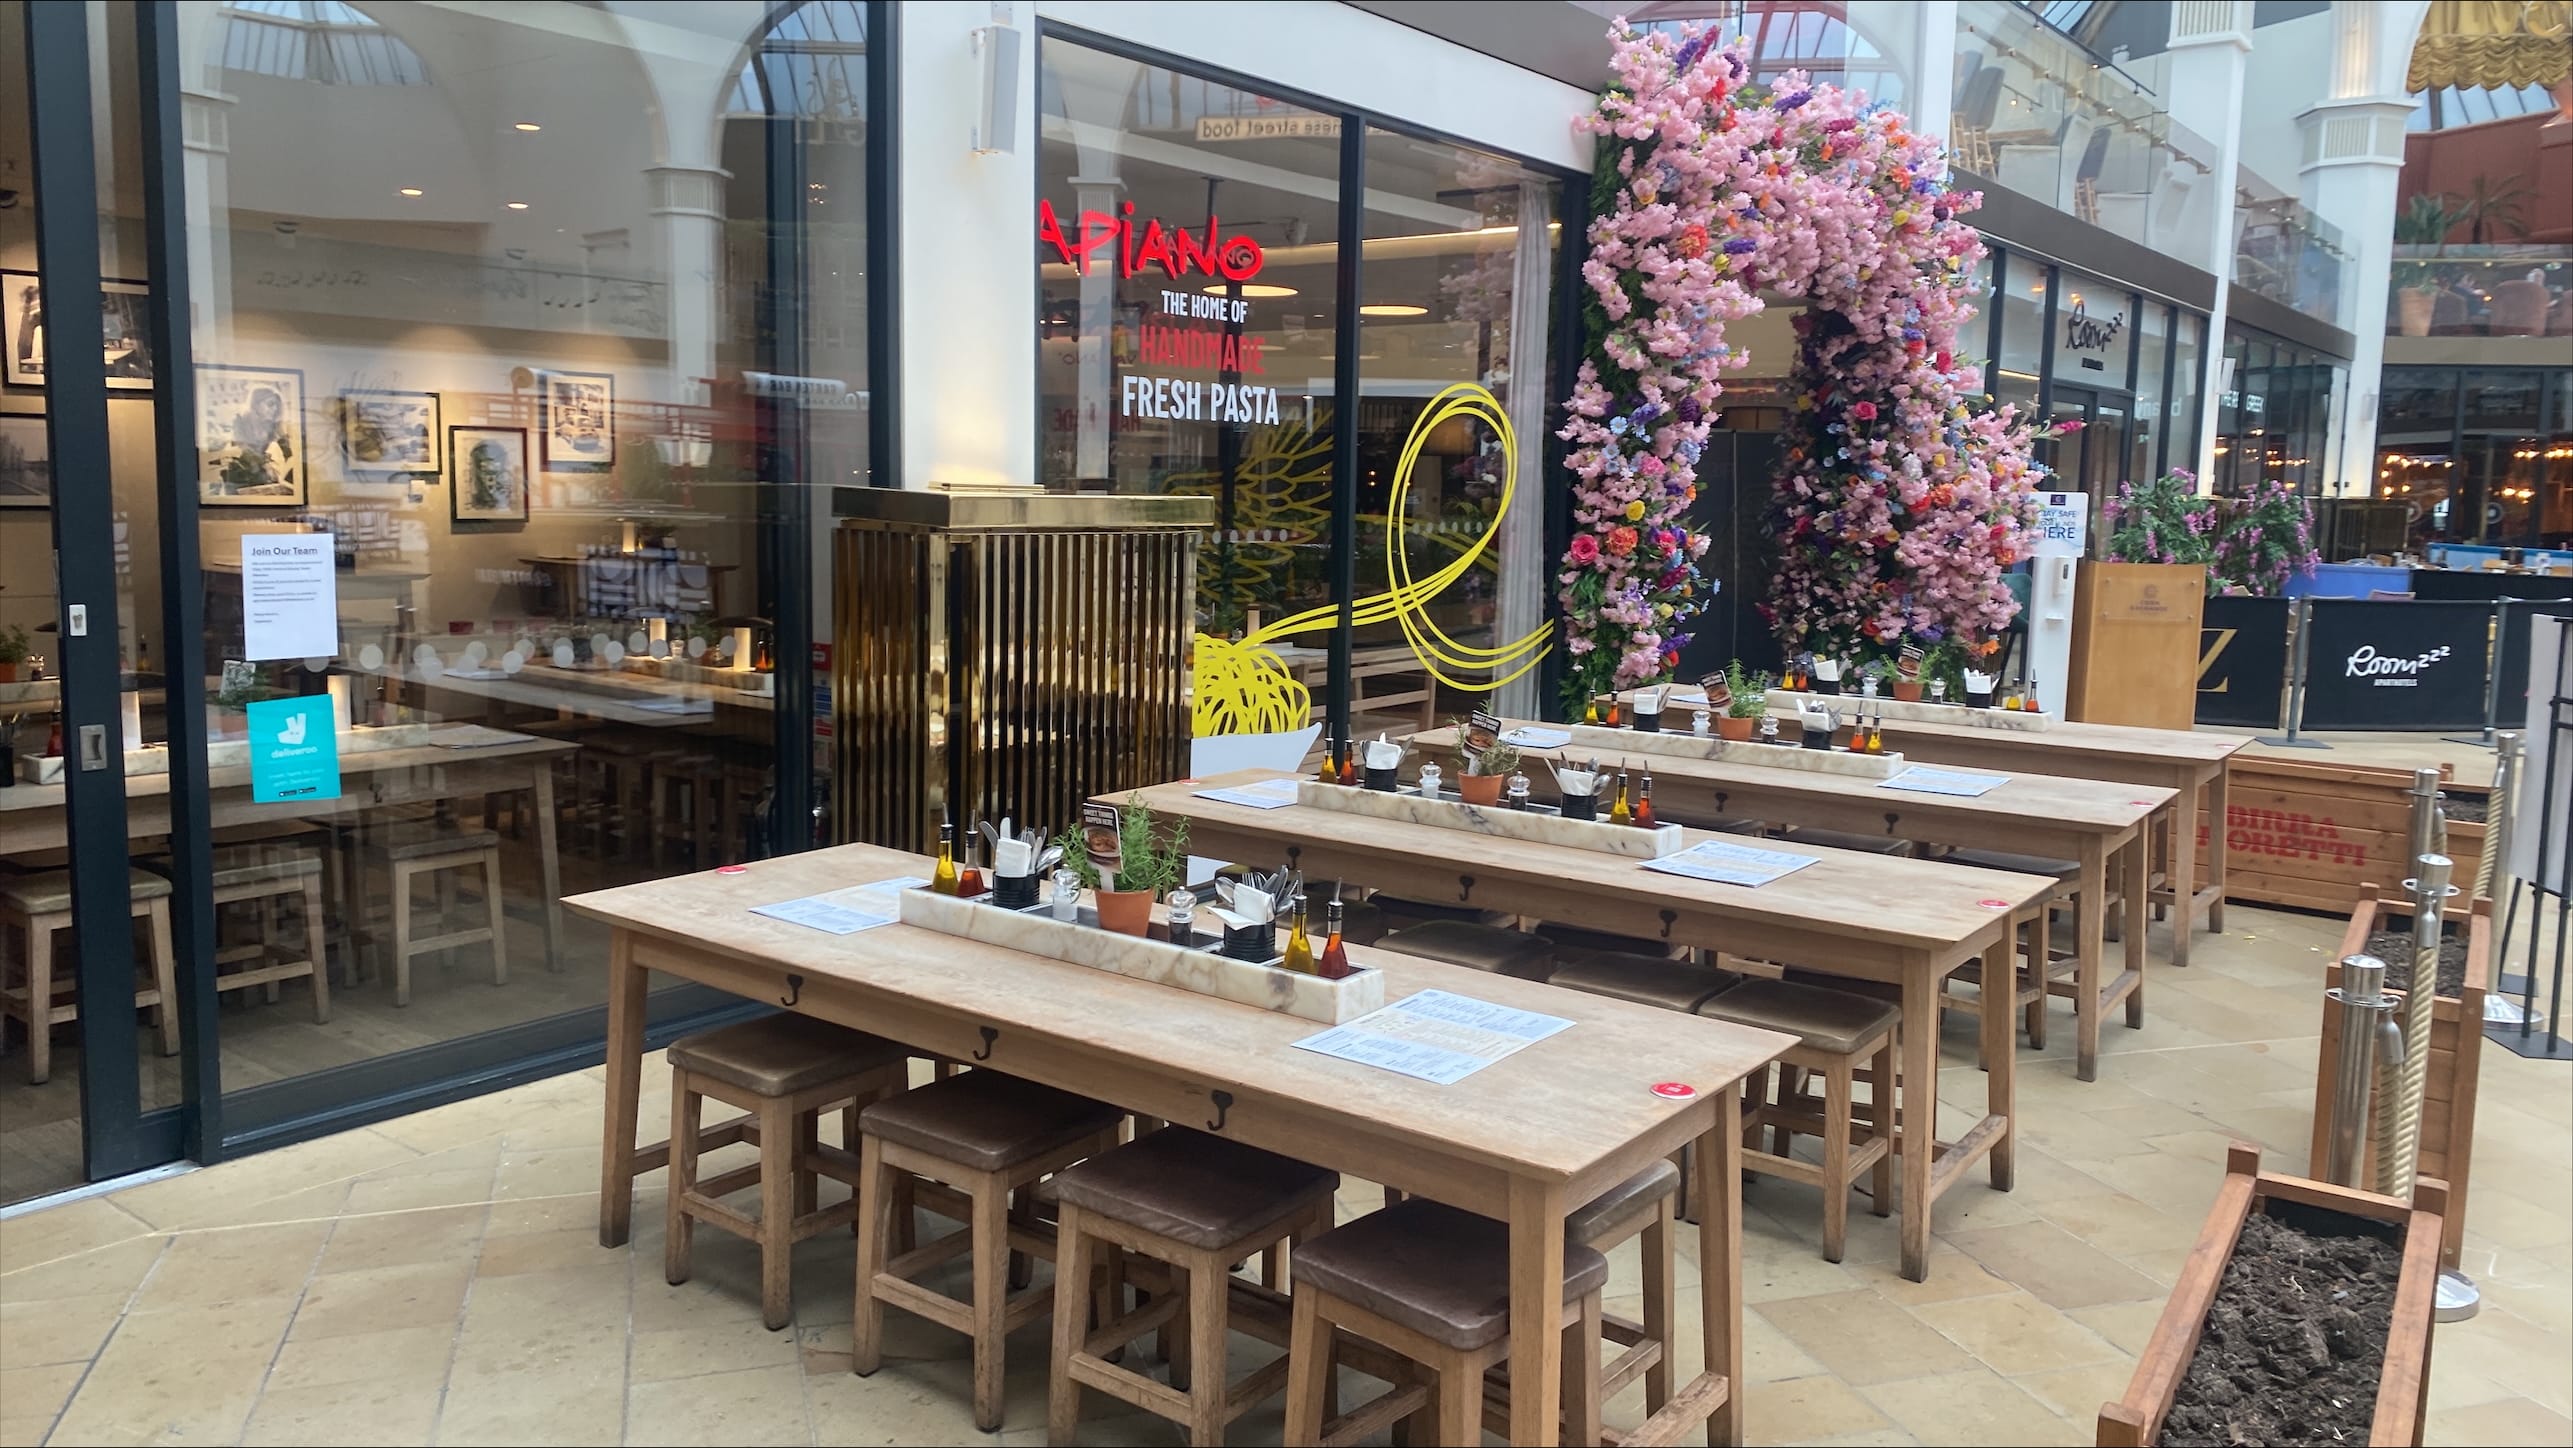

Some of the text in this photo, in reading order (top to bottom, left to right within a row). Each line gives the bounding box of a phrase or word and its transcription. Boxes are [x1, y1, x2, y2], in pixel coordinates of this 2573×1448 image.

[1161, 290, 1249, 324] THE HOME OF
[1139, 324, 1265, 375] HANDMADE
[1123, 375, 1200, 421] FRESH
[1210, 383, 1280, 426] PASTA
[252, 546, 318, 557] Join Our Team
[2227, 805, 2340, 839] BIRRA
